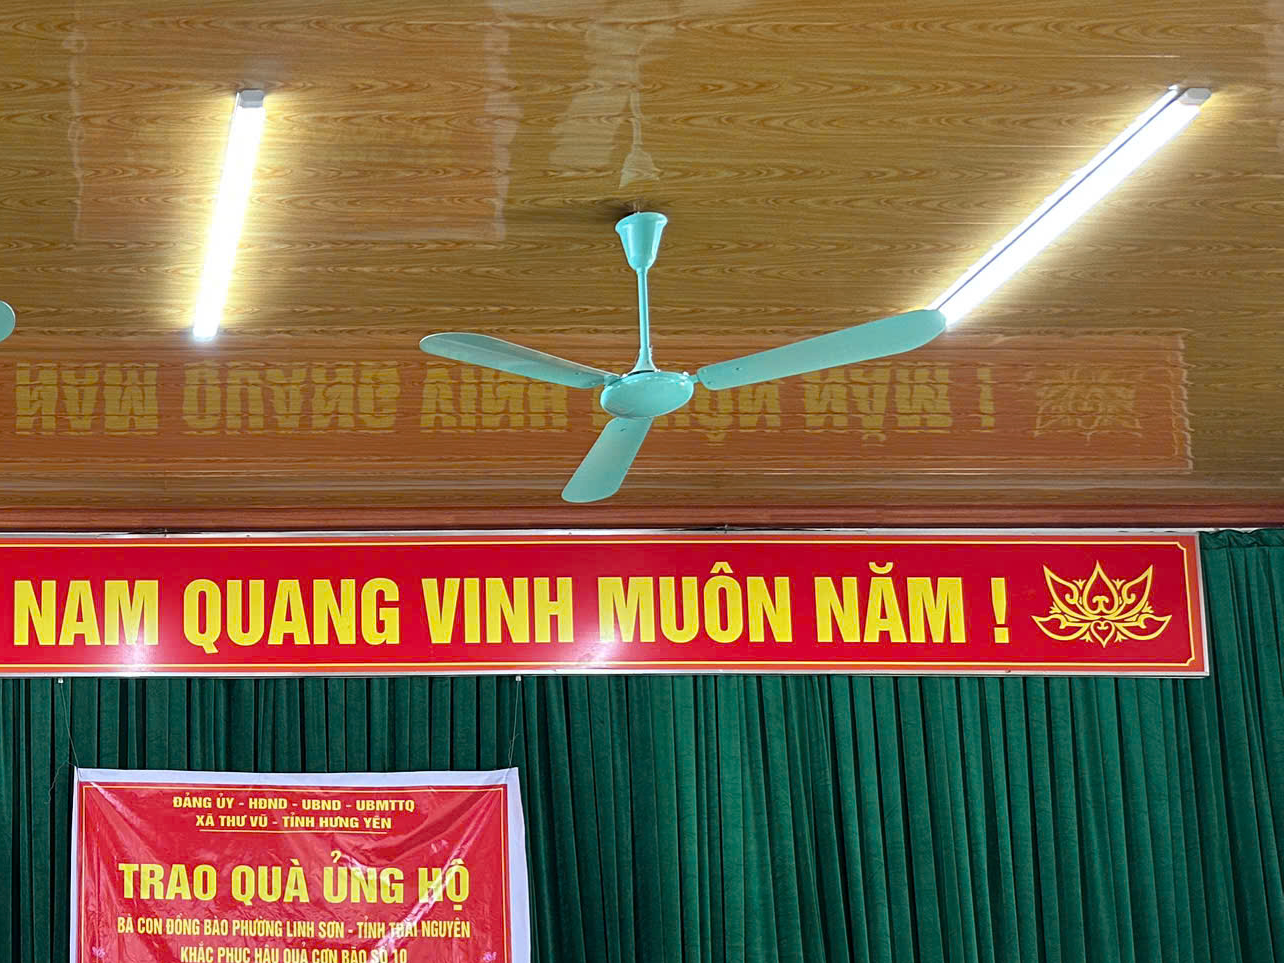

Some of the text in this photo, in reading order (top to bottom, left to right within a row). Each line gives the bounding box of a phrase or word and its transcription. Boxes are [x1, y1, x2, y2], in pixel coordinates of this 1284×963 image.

[14, 579, 159, 646] NAM
[183, 577, 401, 654] QUANG
[421, 577, 574, 644] VINH
[598, 561, 793, 644] MUÔN
[814, 562, 967, 643] NĂM
[173, 792, 212, 808] ĐẢNG
[216, 793, 234, 808] ỦY
[249, 798, 287, 809] HĐND
[302, 799, 341, 810] UBND
[356, 799, 415, 812] UBMTTQ
[196, 813, 215, 826] XÃ
[219, 815, 247, 827] THƯ
[249, 814, 268, 827] VŨ
[282, 812, 315, 828] TỈNH
[319, 816, 359, 828] HƯNG
[364, 815, 392, 829] YÊN
[118, 850, 470, 911] TRAO QUÀ ỦNG HỘ
[117, 914, 134, 933] BÀ
[137, 917, 163, 934] CON
[166, 913, 201, 935] ĐỒNG
[232, 915, 283, 937] PHƯỜNG
[286, 920, 315, 938] LINH
[318, 920, 345, 939] SƠN
[356, 915, 386, 938] TỈNH
[421, 917, 471, 938] NGUYÊN
[180, 941, 214, 963] KHẮC
